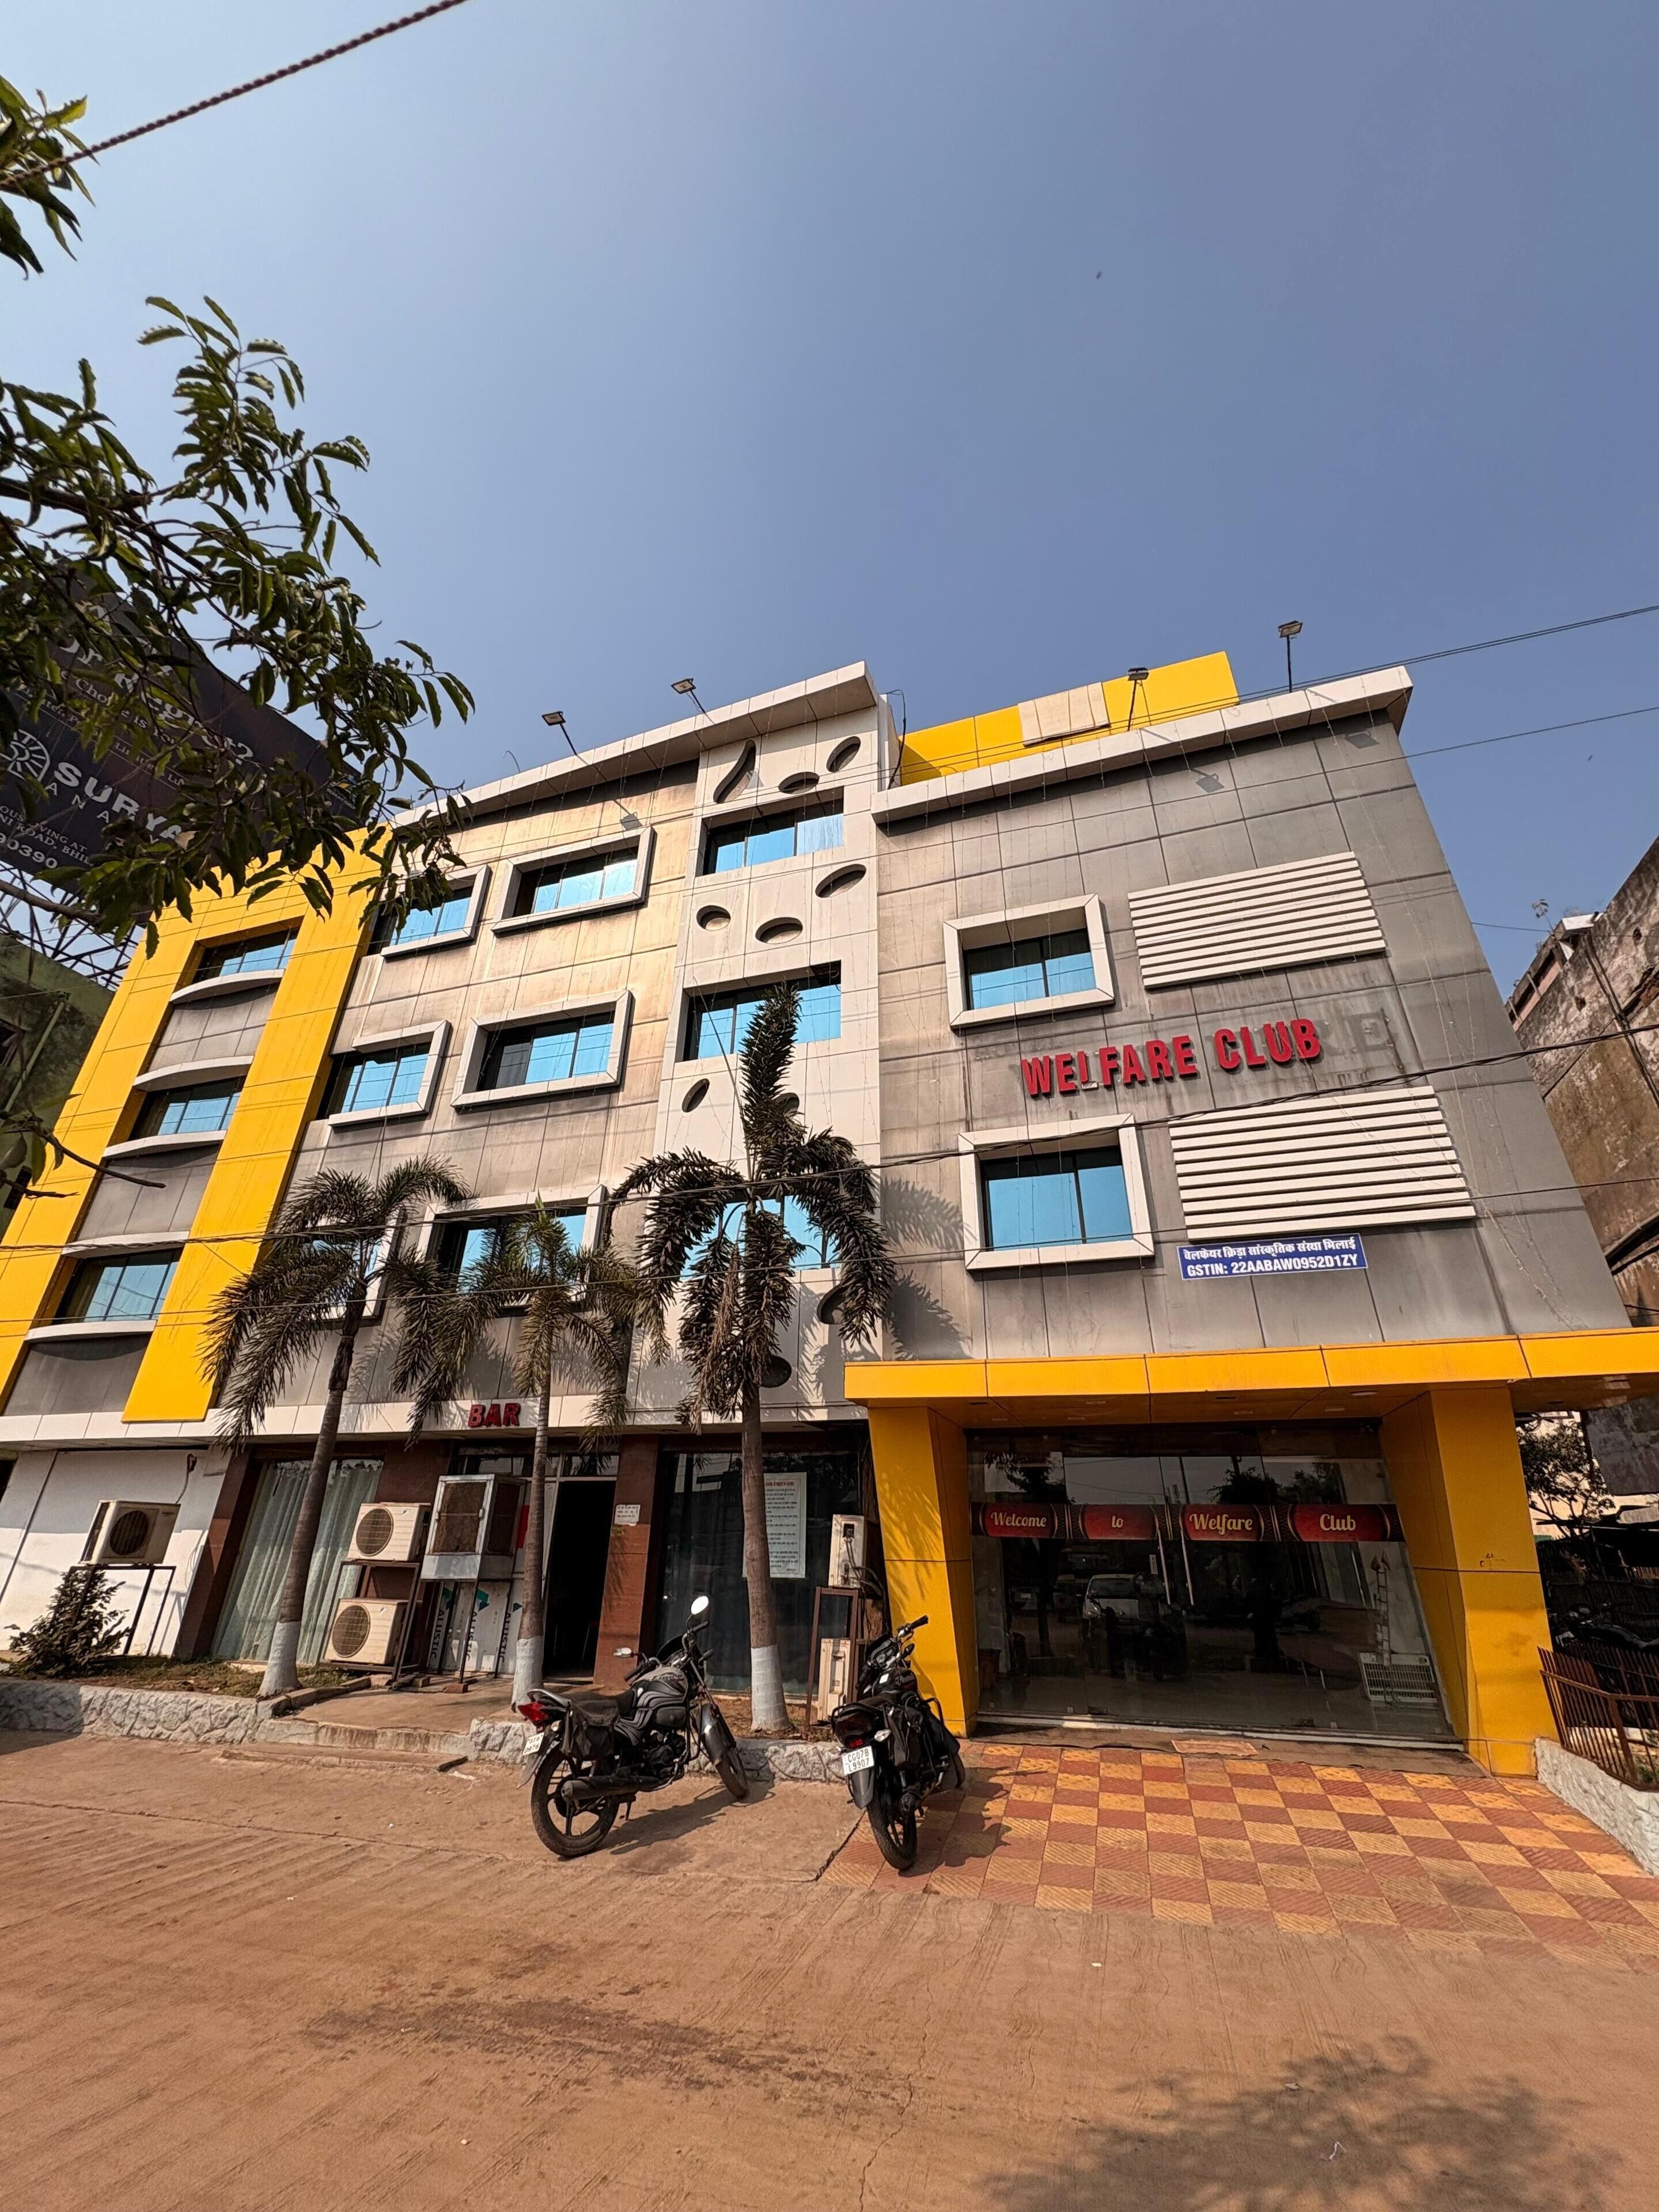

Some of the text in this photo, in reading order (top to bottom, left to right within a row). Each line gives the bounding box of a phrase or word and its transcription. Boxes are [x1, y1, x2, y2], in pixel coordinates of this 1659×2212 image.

[75, 678, 128, 718] Choe
[54, 762, 183, 839] SURYA
[70, 842, 88, 853] AT
[1021, 1035, 1198, 1096] WELFARE
[1213, 1018, 1321, 1070] CLUB
[1323, 1236, 1356, 1251] भिलाई
[1187, 1253, 1358, 1277] GSTIN: 22AABAW0952D1ZY
[468, 1403, 521, 1427] BAR
[991, 1512, 1356, 1535] Welcome to Welfare Club
